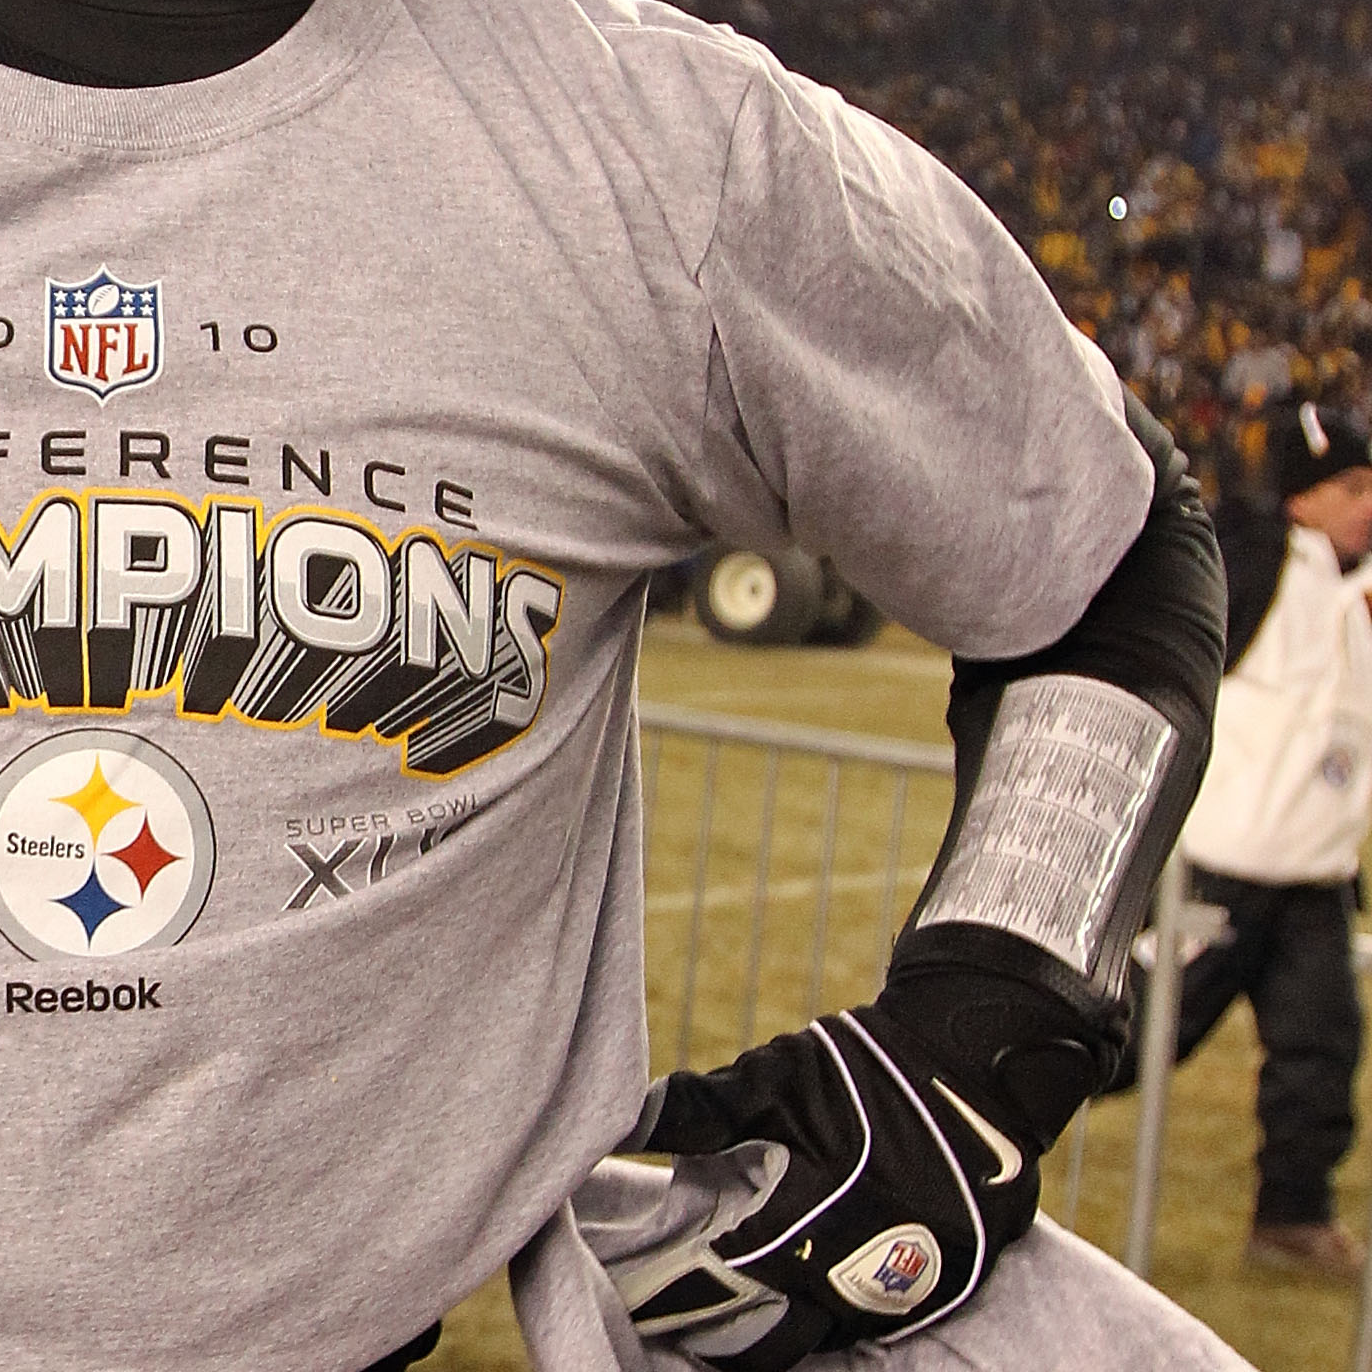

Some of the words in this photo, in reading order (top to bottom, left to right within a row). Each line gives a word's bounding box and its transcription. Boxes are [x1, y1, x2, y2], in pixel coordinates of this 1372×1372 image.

[59, 322, 149, 382] NFL
[199, 320, 279, 353] 10
[285, 813, 389, 838] SUPER
[6, 831, 86, 859] Steelers
[5, 976, 163, 1013] Reebok
